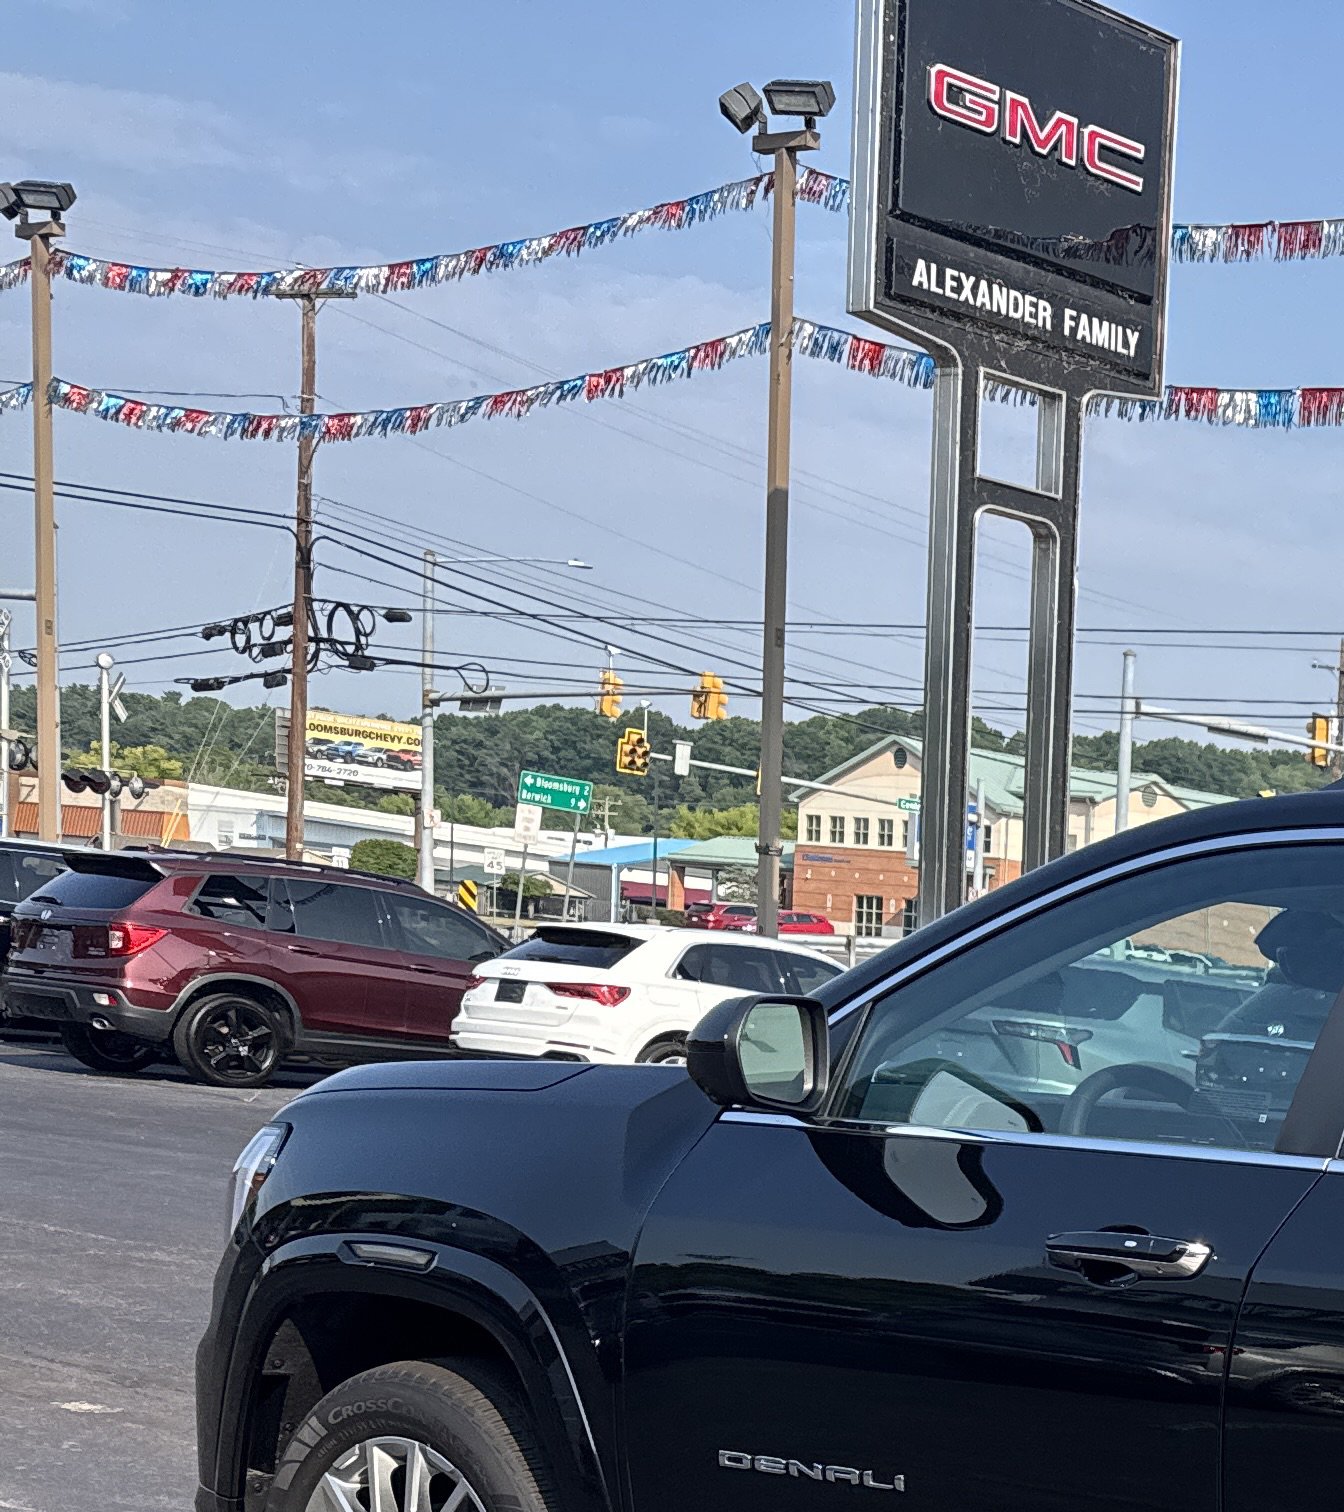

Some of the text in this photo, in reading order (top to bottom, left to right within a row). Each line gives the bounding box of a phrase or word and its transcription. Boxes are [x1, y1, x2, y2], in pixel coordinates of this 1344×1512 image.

[928, 63, 1145, 193] GMC
[911, 258, 1140, 358] ALEXANDER FAMILY
[306, 722, 422, 747] OOMSBURGCHEVY.CO
[521, 789, 576, 807] Berwick 9
[536, 777, 590, 796] Bloomsburg 2
[486, 860, 503, 871] 45
[718, 1449, 905, 1492] DENALI
